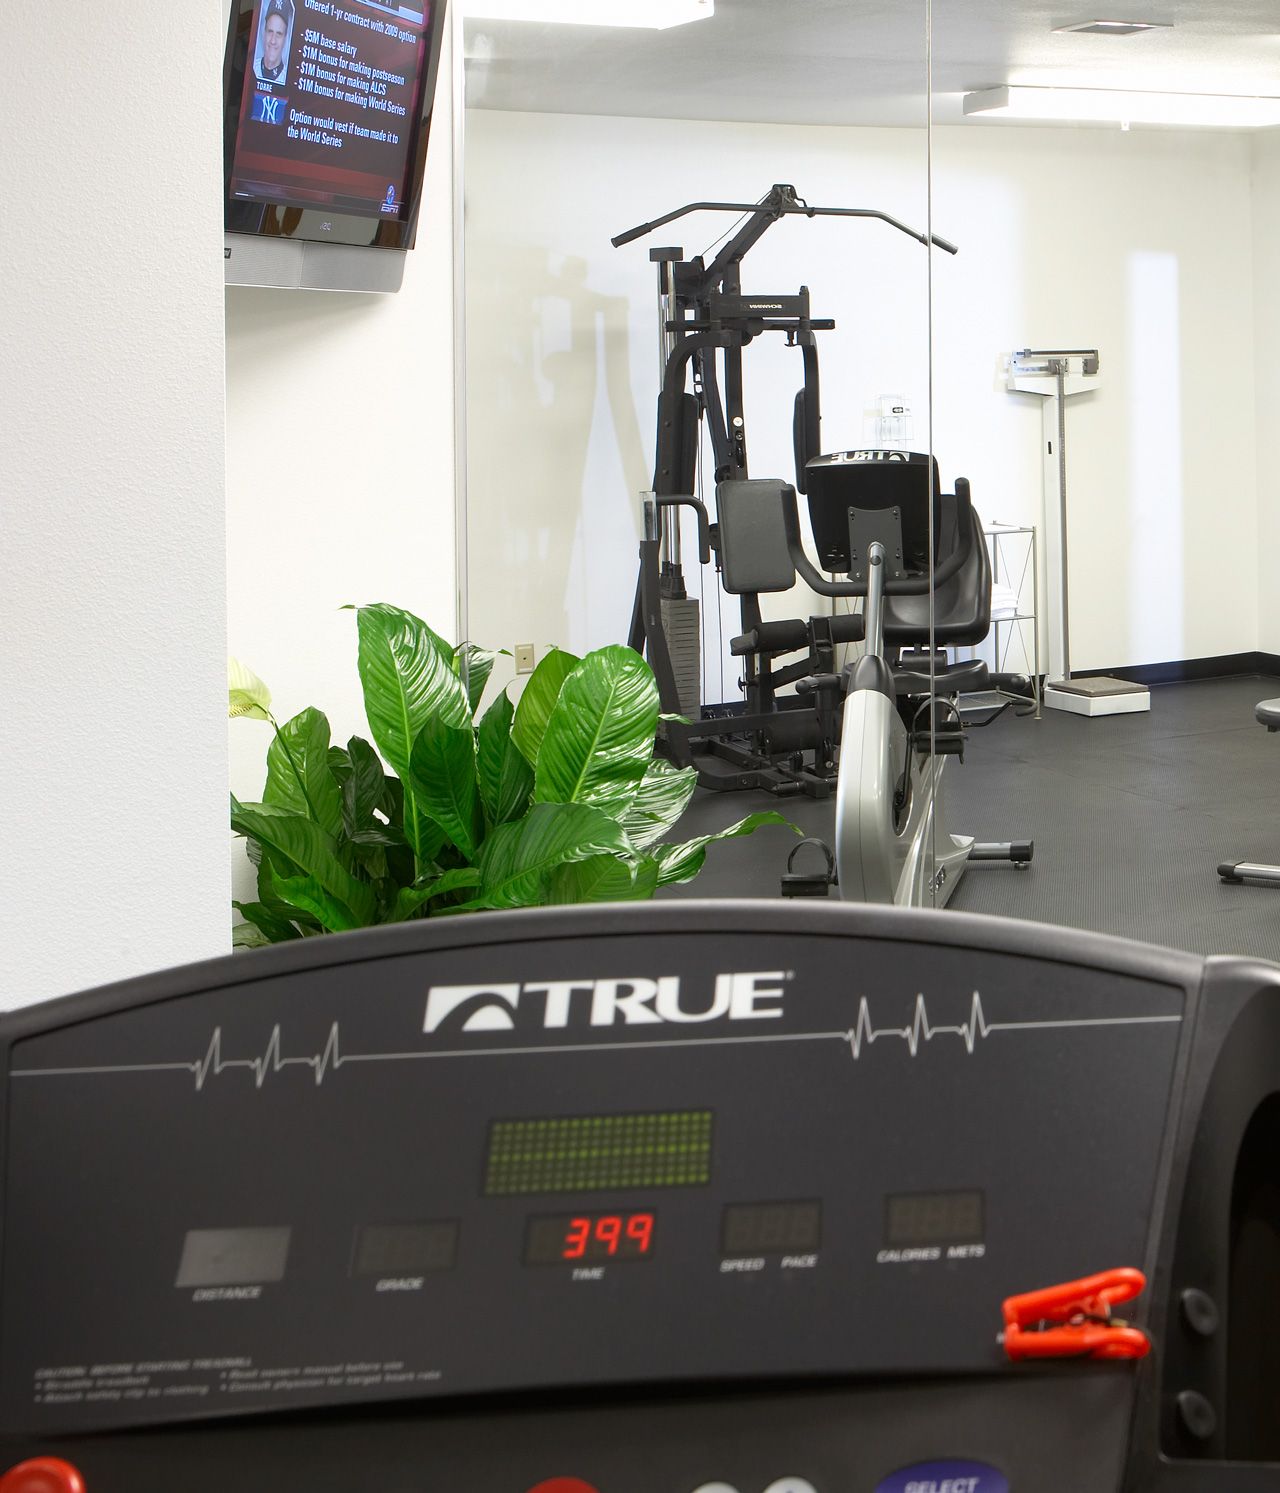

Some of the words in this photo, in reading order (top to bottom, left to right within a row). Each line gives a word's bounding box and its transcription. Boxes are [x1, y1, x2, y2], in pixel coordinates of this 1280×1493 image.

[331, 5, 344, 20] 1-yr
[344, 12, 370, 28] contract
[371, 20, 384, 32] with
[385, 23, 399, 37] 2009
[399, 29, 417, 43] option
[304, 28, 320, 44] $5M
[320, 34, 336, 49] base
[337, 41, 357, 58] salary
[300, 61, 315, 76] $1M
[316, 65, 336, 82] bonus
[337, 72, 346, 84] for
[347, 77, 369, 93] making
[370, 80, 387, 95] ALCS
[302, 45, 318, 60] $1M
[318, 50, 338, 66] bonus
[339, 56, 348, 69] for
[349, 61, 371, 78] making
[371, 68, 405, 85] postseason
[298, 77, 313, 92] $1M
[314, 81, 334, 98] bonus
[335, 87, 344, 100] for
[345, 92, 368, 109] making
[368, 96, 387, 111] World
[387, 101, 406, 116] Series
[287, 126, 299, 139] the
[299, 127, 321, 143] World
[321, 133, 343, 148] Series
[290, 109, 312, 126] Option
[313, 115, 334, 130] would
[334, 121, 349, 133] vest
[354, 125, 369, 137] team
[370, 129, 386, 142] made
[523, 971, 785, 1028] TRUE
[563, 1213, 654, 1259] 399
[720, 1258, 765, 1272] SPEED
[780, 1254, 818, 1268] PACE
[877, 1247, 941, 1263] CALORIES
[947, 1244, 985, 1258] METS
[376, 1277, 425, 1292] GRADE
[572, 1267, 605, 1280] TIME
[193, 1286, 262, 1302] DISTANCE
[904, 1477, 980, 1493] SELECT
